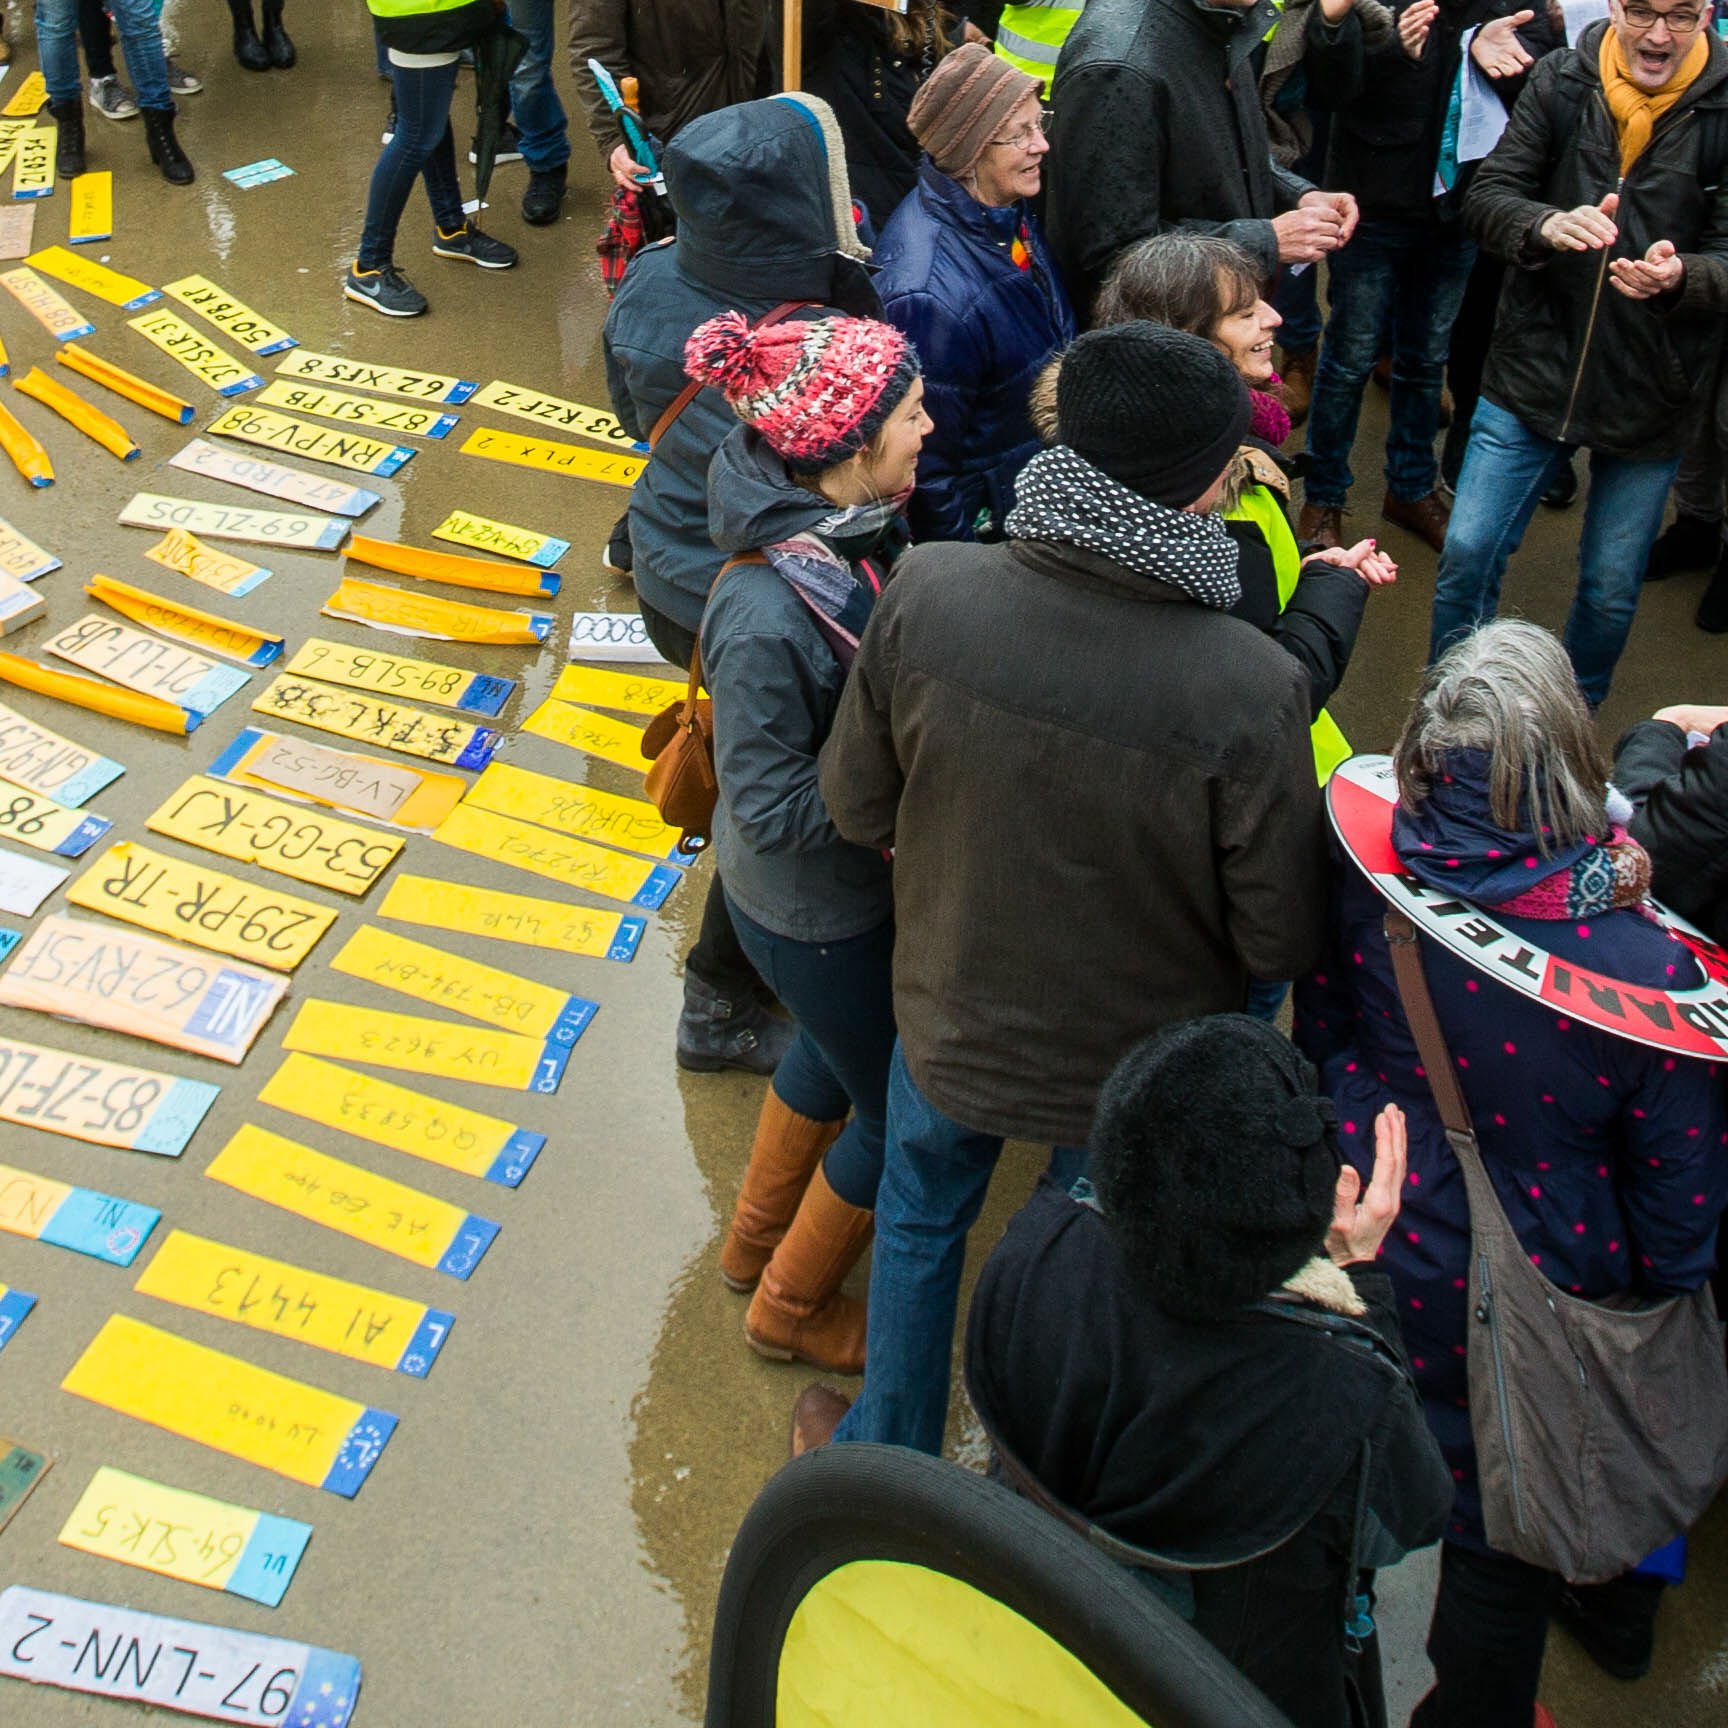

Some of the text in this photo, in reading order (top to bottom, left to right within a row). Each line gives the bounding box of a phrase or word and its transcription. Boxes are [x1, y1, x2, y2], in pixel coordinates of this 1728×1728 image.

[218, 408, 390, 465] RN-PV-98
[297, 643, 465, 698] 89-SLB-6
[168, 789, 391, 880] 53-GG-KJ
[103, 856, 315, 953] 29-PR-TR
[213, 973, 263, 1039] NL
[8, 1610, 297, 1719] 97-LNN-2
